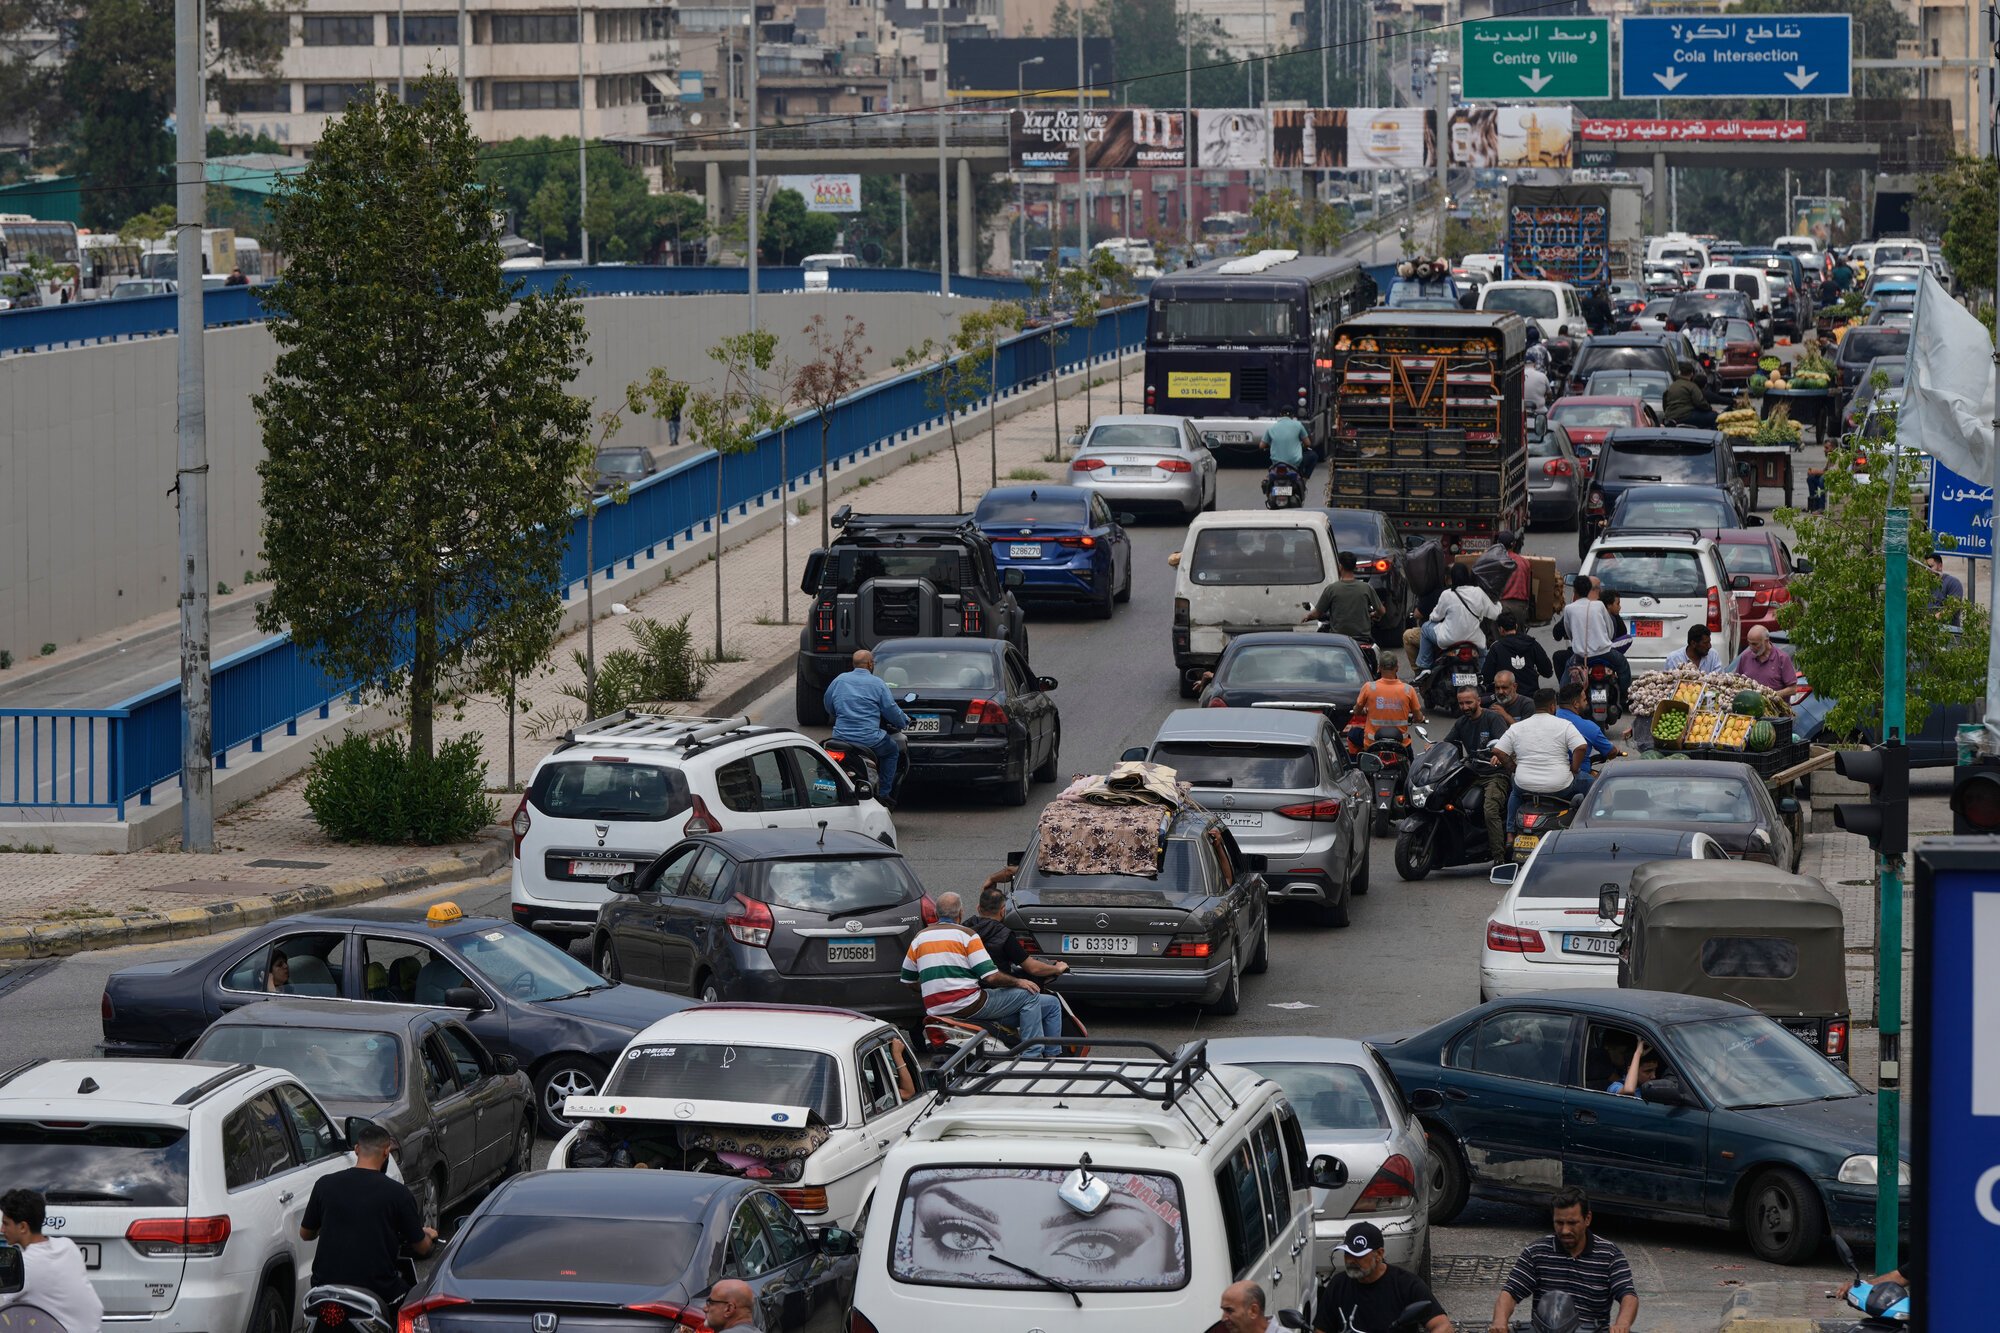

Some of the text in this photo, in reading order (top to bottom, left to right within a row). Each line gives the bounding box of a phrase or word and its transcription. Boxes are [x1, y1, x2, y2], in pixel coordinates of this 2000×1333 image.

[1474, 25, 1597, 45] وسط المدينة
[1670, 23, 1801, 44] تقاطع الكولا
[1493, 52, 1578, 65] Centre Ville
[1673, 49, 1798, 62] Cola Intersection
[1022, 111, 1052, 127] Your
[1742, 125, 1777, 138] يسب
[1780, 123, 1803, 139] من
[1022, 152, 1069, 160] ELEGANCE
[1137, 152, 1184, 160] ELEGANCE
[1525, 227, 1590, 244] TOYOTA
[1938, 532, 1986, 548] Cmille
[1011, 547, 1040, 557] S286270
[444, 907, 459, 916] TAXI
[1071, 937, 1129, 951] G 633913
[1572, 937, 1580, 949] G
[829, 946, 875, 960] B705681
[1123, 1174, 1182, 1228] MALAK
